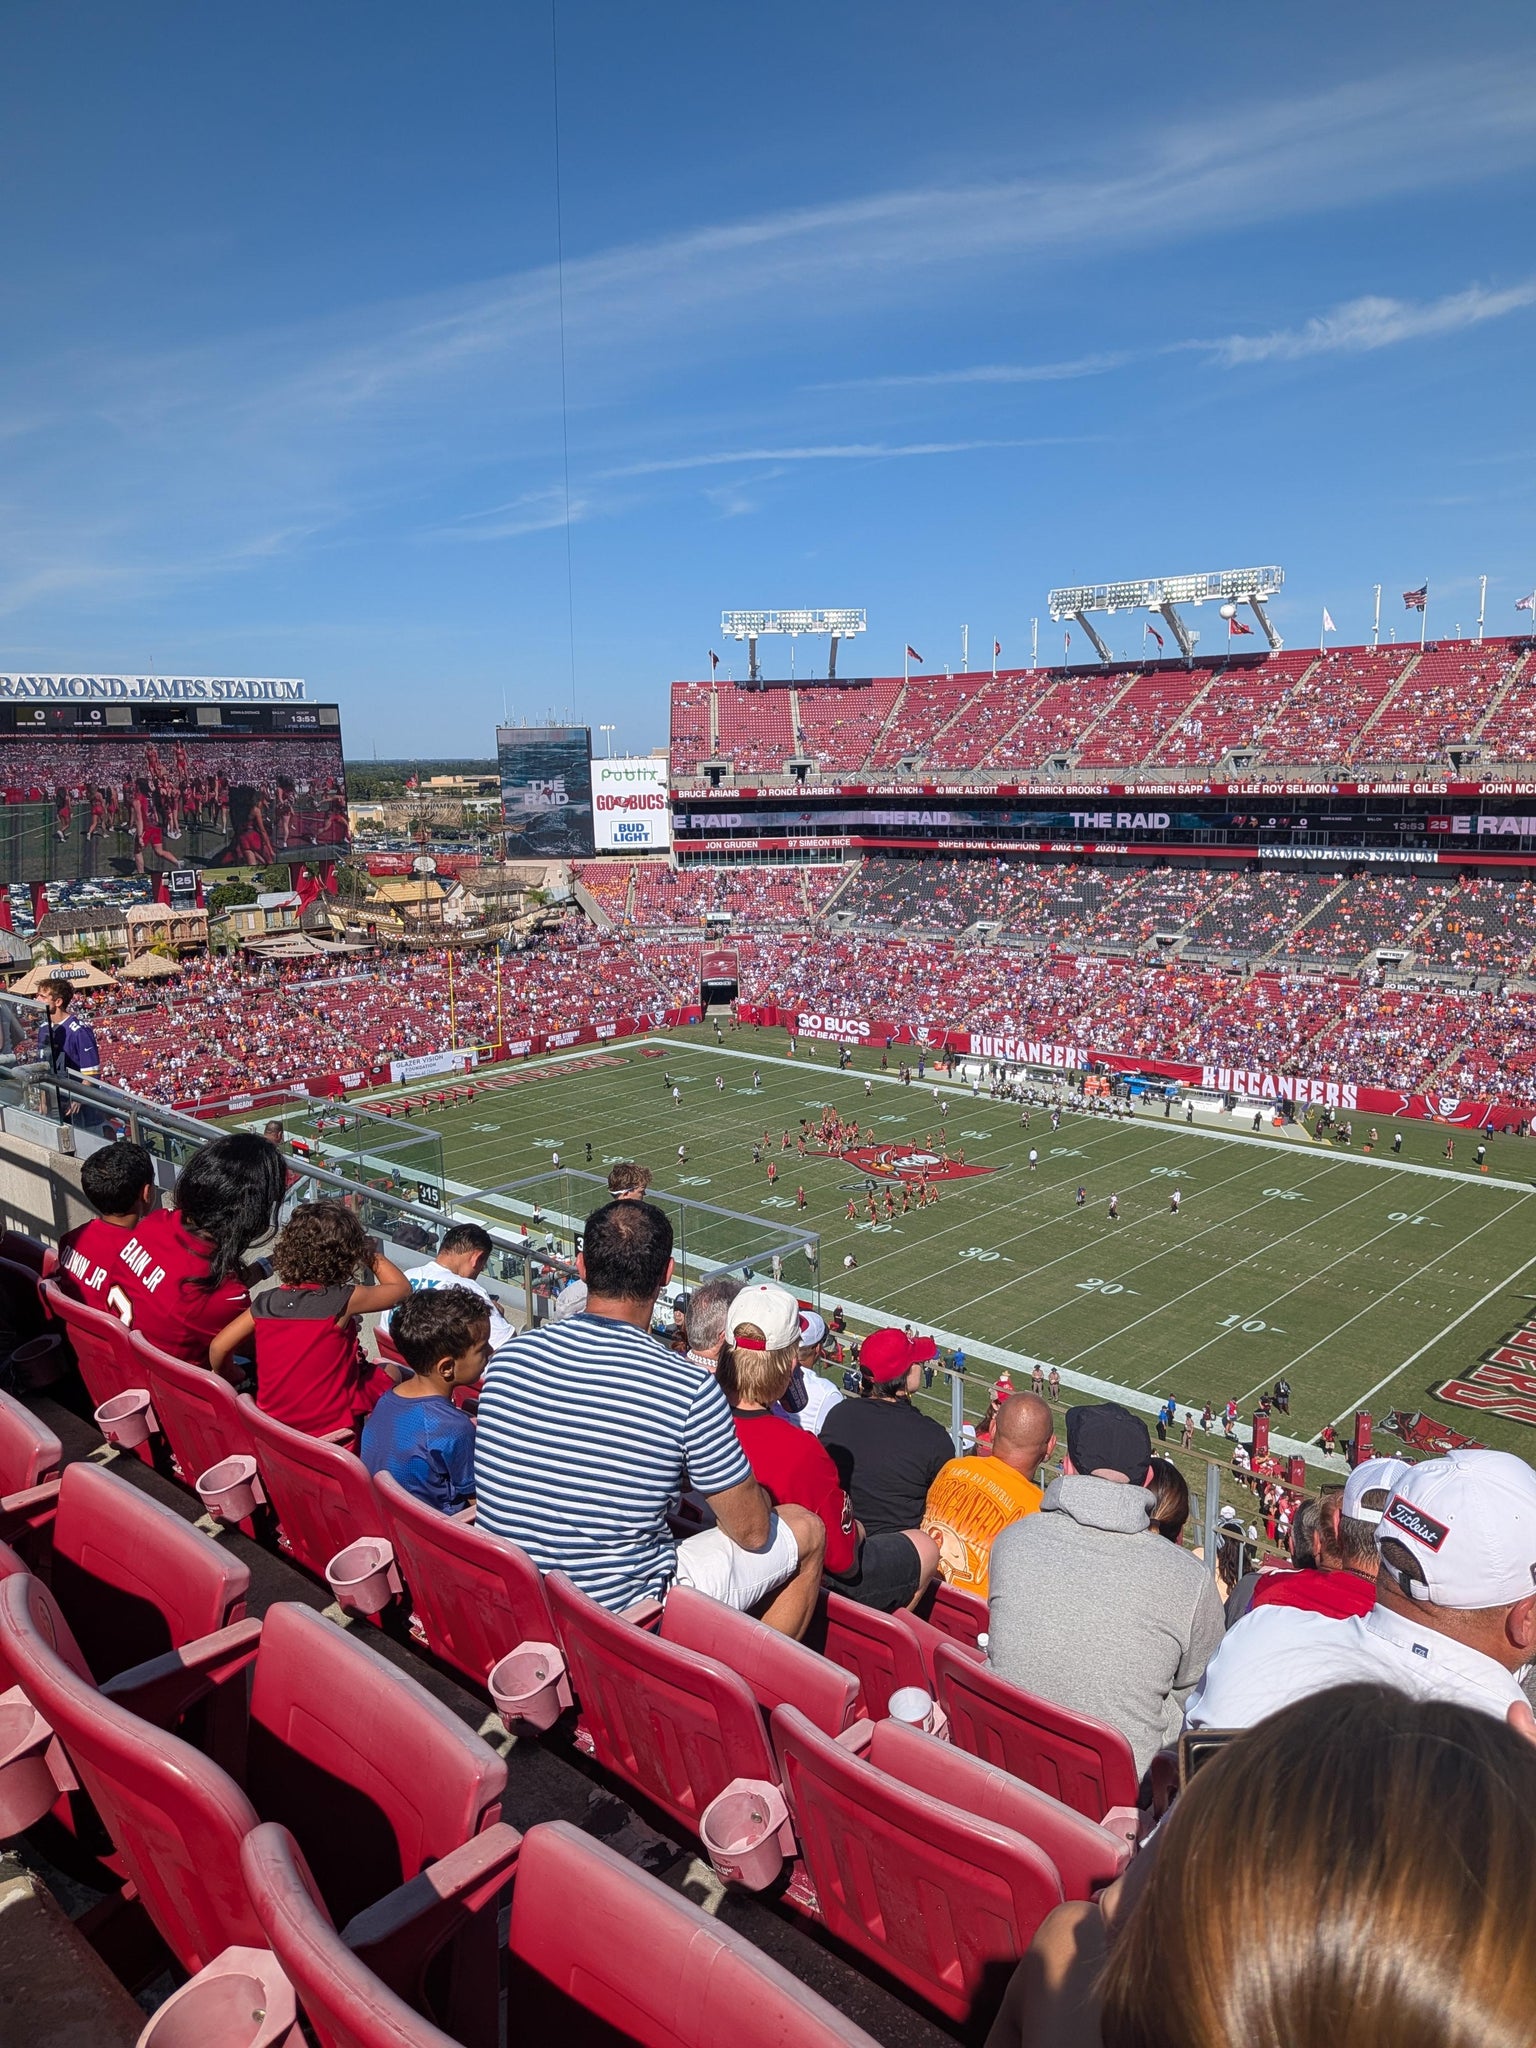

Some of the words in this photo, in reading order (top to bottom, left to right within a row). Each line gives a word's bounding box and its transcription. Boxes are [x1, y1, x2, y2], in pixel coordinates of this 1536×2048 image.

[0, 676, 127, 697] RAYMOND
[130, 678, 207, 698] JAMES
[211, 680, 304, 699] STADIUM
[291, 715, 317, 723] 13:53
[601, 768, 659, 781] Publix
[527, 779, 565, 792] THE
[757, 788, 767, 797] 20
[801, 786, 835, 796] BARBER
[867, 787, 875, 795] 47
[876, 786, 895, 795] JOHN
[896, 786, 918, 795] LYNCH
[936, 787, 945, 795] 40
[946, 786, 963, 794] MIKE
[965, 786, 998, 795] ALSTOTT
[1018, 786, 1027, 795] 55
[1029, 786, 1064, 795] DERRICK
[1066, 786, 1102, 795] BROOKS
[1125, 786, 1135, 794] 99
[1137, 786, 1174, 795] WARREN
[1178, 785, 1203, 794] SAPP
[1228, 785, 1239, 794] 63
[1241, 784, 1260, 794] LEE
[1262, 784, 1284, 794] ROY
[1286, 784, 1330, 794] SELMON
[1357, 784, 1370, 793] 88
[1372, 784, 1410, 794] JIMMIE
[1413, 784, 1447, 793] GILES
[1479, 784, 1512, 794] JOHN
[523, 793, 569, 805] RAID
[678, 790, 707, 798] BRUCE
[709, 789, 740, 798] ARIANS
[596, 794, 614, 811] GO
[629, 794, 664, 810] BUCS
[691, 814, 742, 828] RAID
[870, 811, 905, 825] THE
[908, 811, 950, 825] RAID
[1070, 812, 1112, 828] THE
[1117, 812, 1171, 828] RAID
[618, 823, 644, 832] BUD
[1393, 822, 1425, 831] 13:53
[1430, 820, 1449, 830] 25
[613, 833, 651, 842] LIGHT
[788, 840, 797, 848] 97
[799, 839, 829, 847] SIMEON
[831, 839, 851, 847] RICE
[705, 841, 722, 849] JON
[724, 840, 758, 849] GRUDEN
[938, 840, 964, 849] SUPER
[966, 841, 989, 850] BOWL
[991, 842, 1040, 851] CHAMPIONS
[1095, 844, 1116, 853] 2020
[175, 876, 192, 885] 25
[51, 969, 87, 980] Corona
[798, 1013, 822, 1029] GO
[824, 1016, 870, 1037] BUCS
[798, 1028, 816, 1036] BUC
[817, 1030, 840, 1041] BEAT
[839, 1034, 860, 1044] LINE
[970, 1034, 1088, 1069] BUCCANEERS
[396, 1058, 421, 1068] GLAZER
[423, 1054, 444, 1063] VISION
[405, 1063, 436, 1072] FOUNDATION
[344, 1079, 361, 1089] TROOP
[1202, 1065, 1358, 1110] BUCCANEERS
[229, 1100, 254, 1111] BRIGADE
[420, 1185, 439, 1202] 315
[958, 1247, 1000, 1262] 30
[61, 1245, 91, 1280] ODWIN
[84, 1266, 108, 1291] JR
[120, 1237, 152, 1278] BAIN
[142, 1265, 166, 1293] JR
[1075, 1278, 1124, 1295] 20
[1215, 1314, 1266, 1333] 10
[970, 1473, 987, 1487] BAY
[984, 1479, 1016, 1512] FOOTBALL
[1388, 1503, 1439, 1543] Titleist
